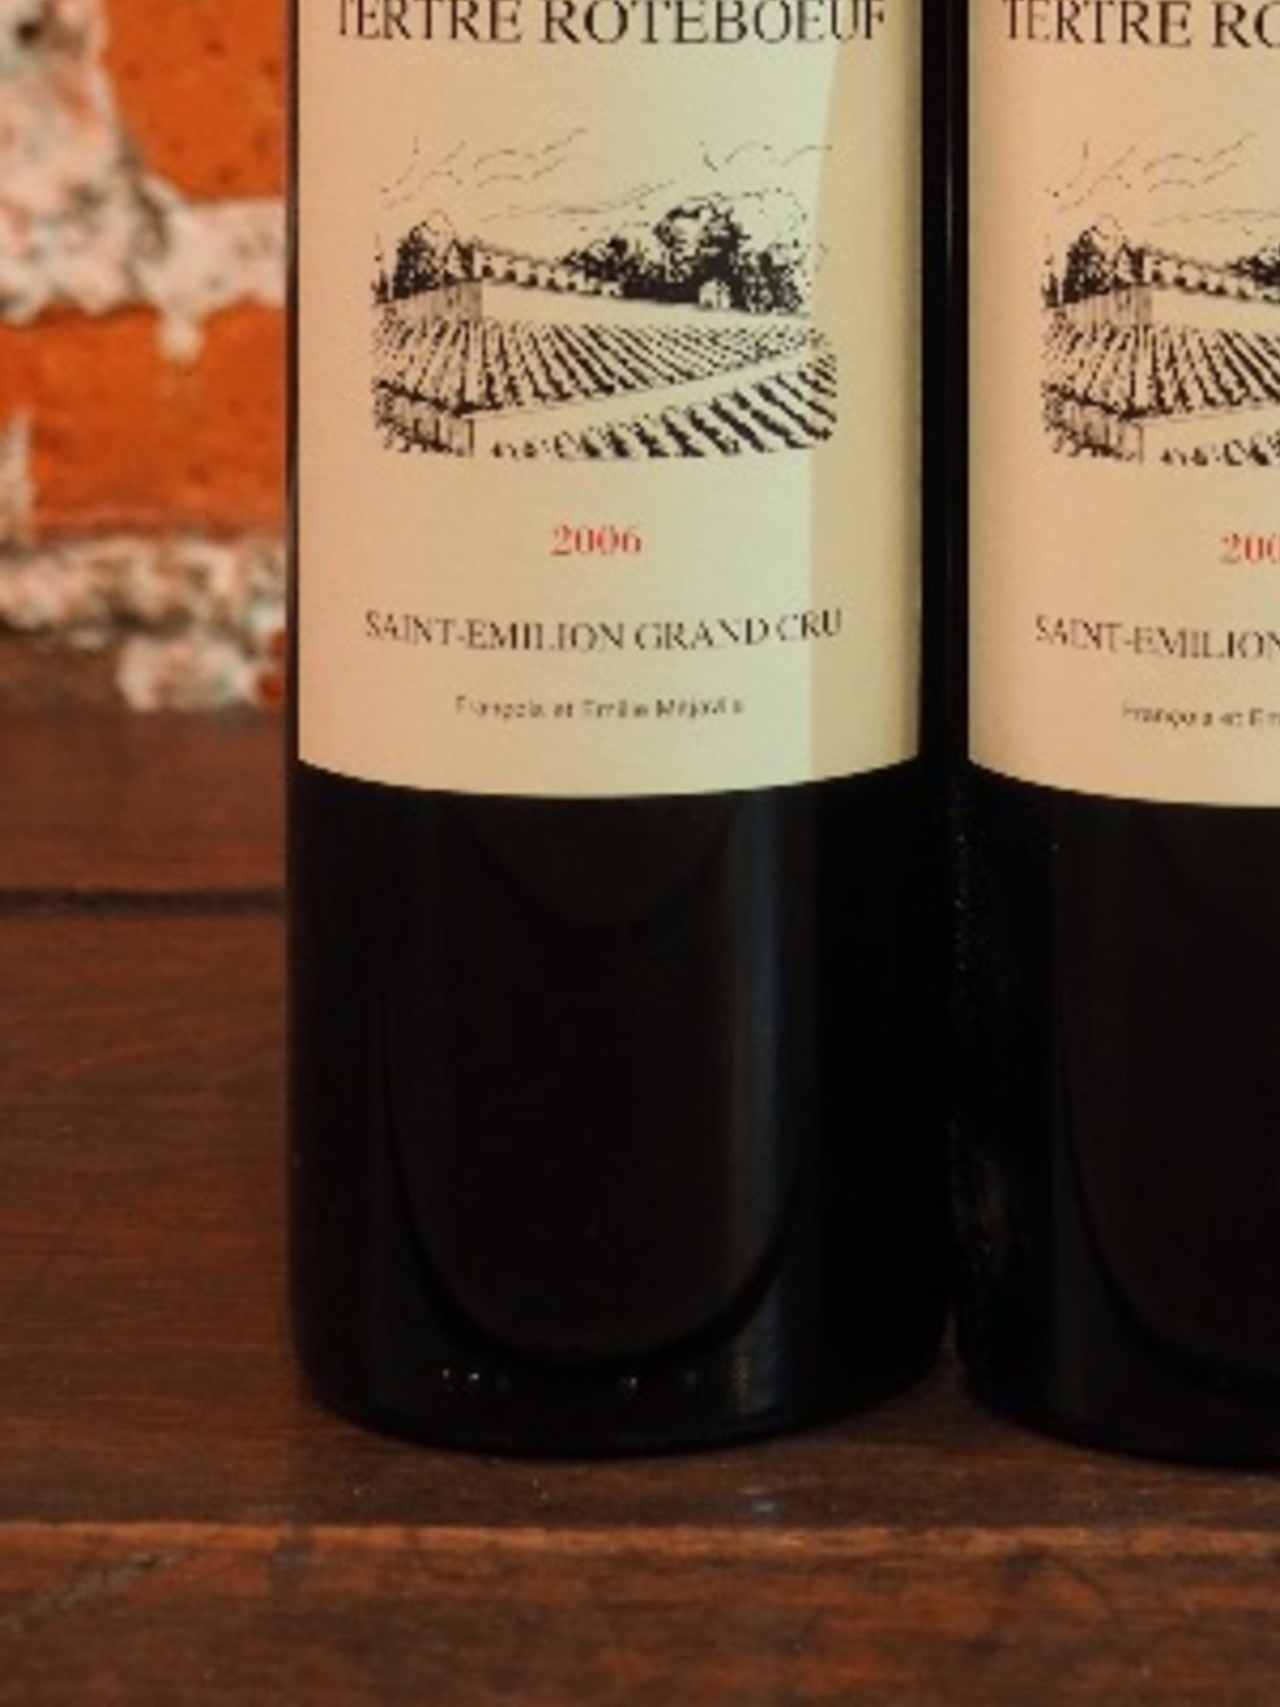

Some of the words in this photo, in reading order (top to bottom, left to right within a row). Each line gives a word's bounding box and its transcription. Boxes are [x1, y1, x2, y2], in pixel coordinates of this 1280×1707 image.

[549, 523, 642, 557] 2006
[364, 609, 625, 652] SAINT-EMILION
[634, 617, 771, 652] GRAND
[774, 607, 843, 642] CRU
